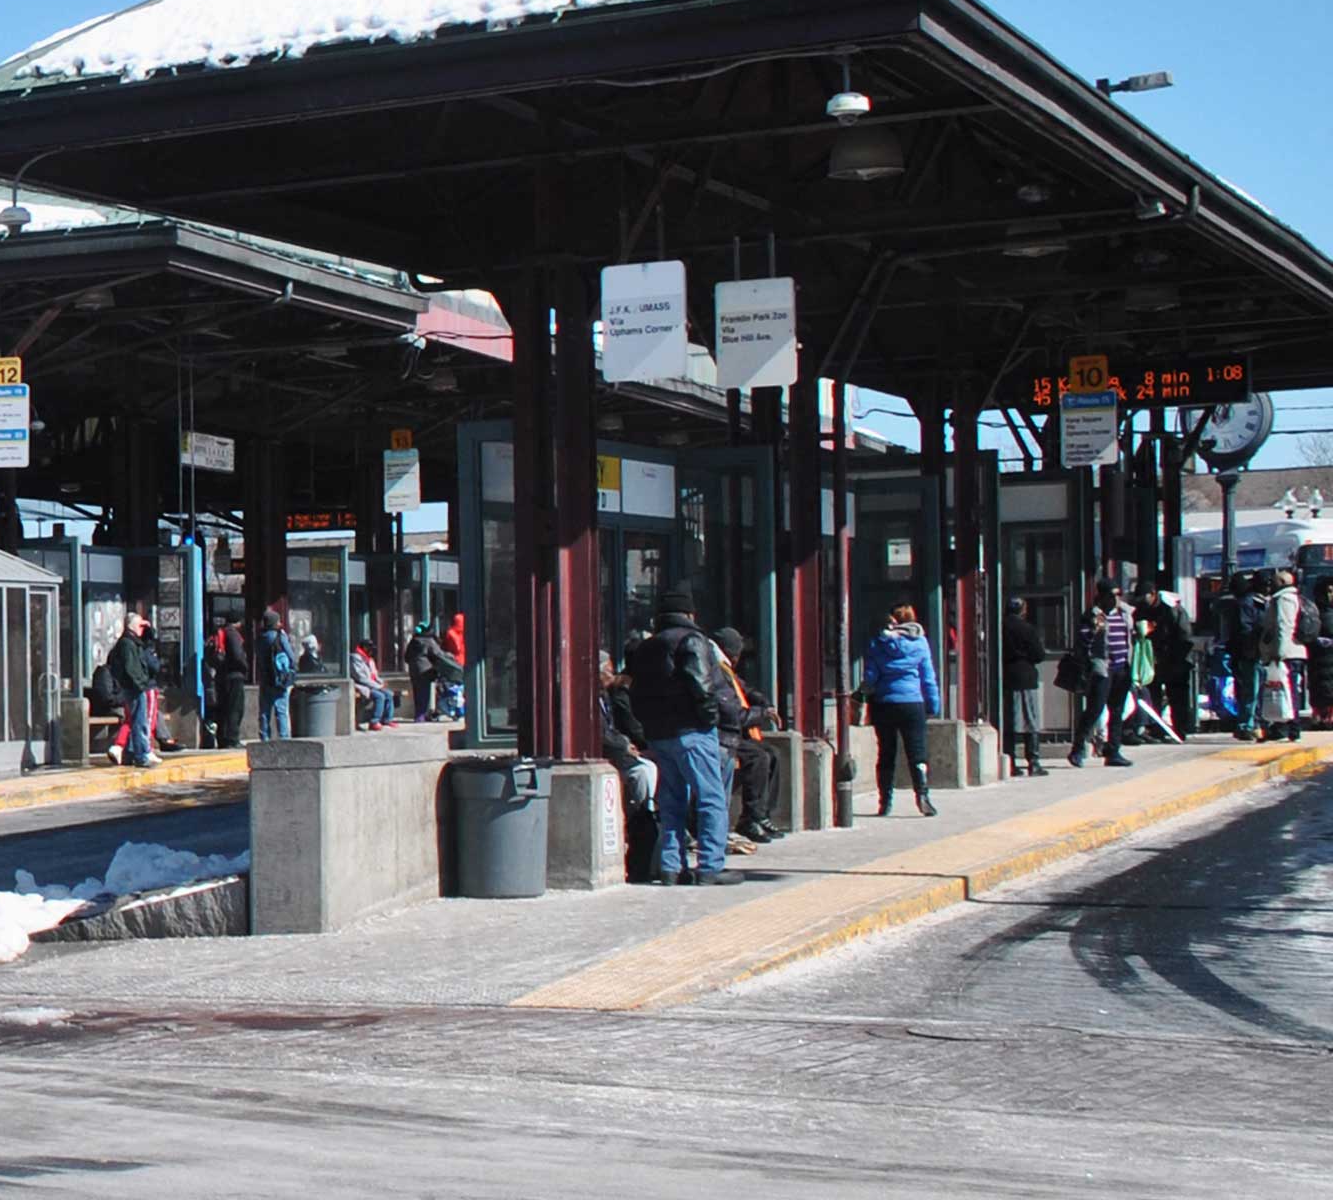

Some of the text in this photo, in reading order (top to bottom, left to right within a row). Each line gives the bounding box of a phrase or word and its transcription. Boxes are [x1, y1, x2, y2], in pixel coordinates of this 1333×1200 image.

[639, 302, 670, 312] UMASS
[609, 318, 624, 326] Via
[720, 310, 788, 323] Franklin Park Zoo
[609, 324, 673, 337] Uphams Corner
[721, 326, 735, 334] Via
[721, 335, 740, 344] Blue
[1076, 368, 1102, 388] 10
[1207, 365, 1243, 382] 1:08
[1034, 377, 1051, 392] 15
[1144, 371, 1154, 385] 8
[1161, 371, 1190, 385] min
[1137, 385, 1154, 400] 24
[1162, 385, 1190, 398] min
